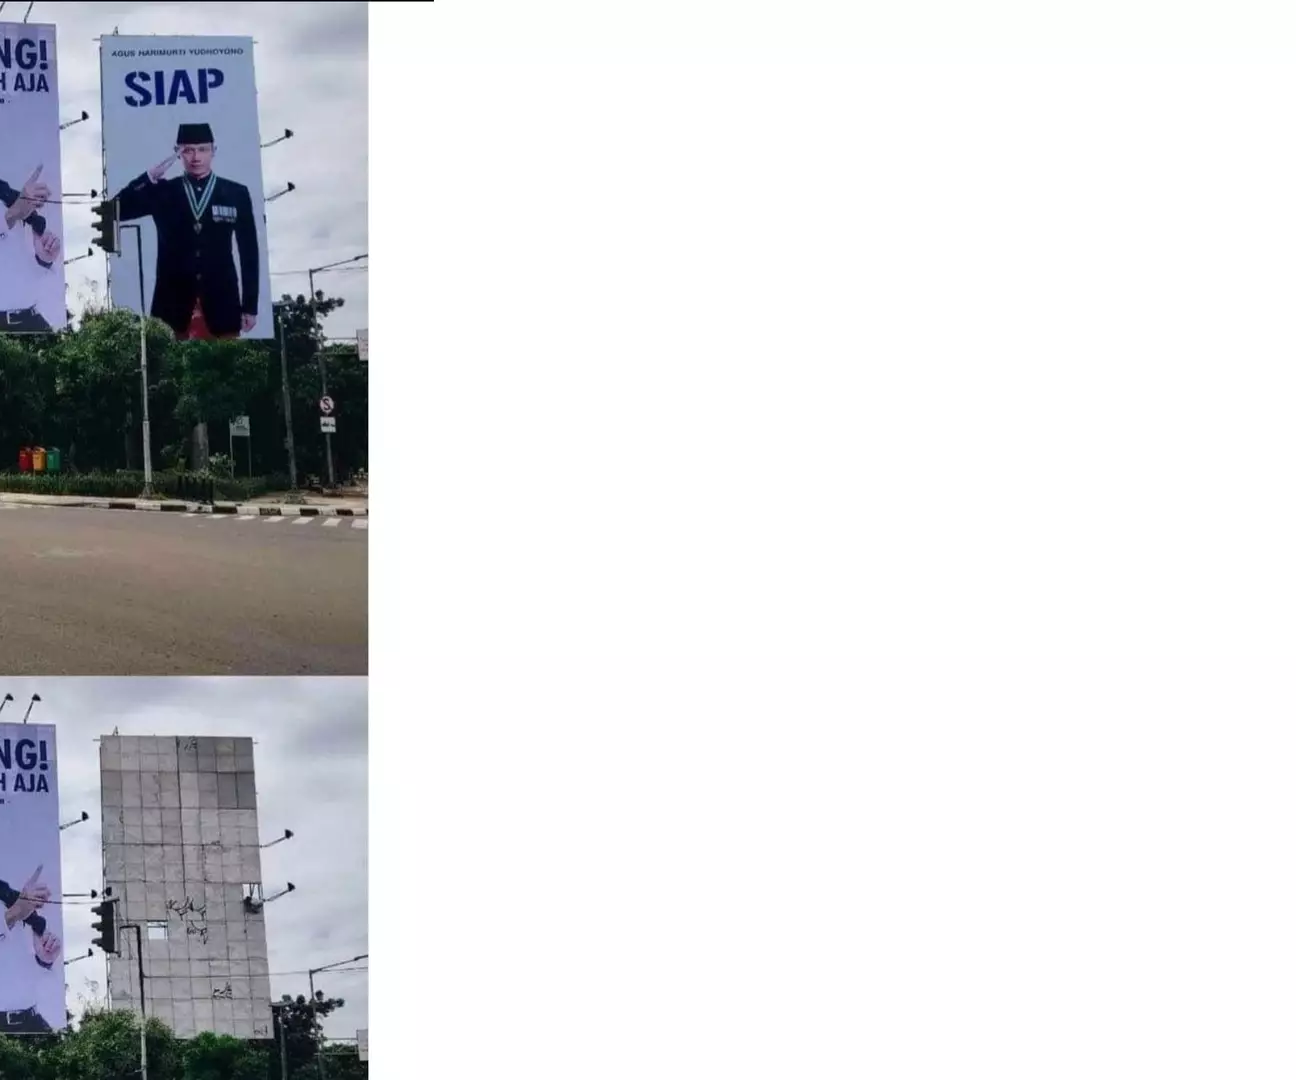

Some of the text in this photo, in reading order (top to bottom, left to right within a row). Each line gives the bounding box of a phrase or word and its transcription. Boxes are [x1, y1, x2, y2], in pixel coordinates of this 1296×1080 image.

[14, 73, 49, 93] AJA
[124, 68, 224, 107] SIAP
[14, 773, 49, 793] AJA
